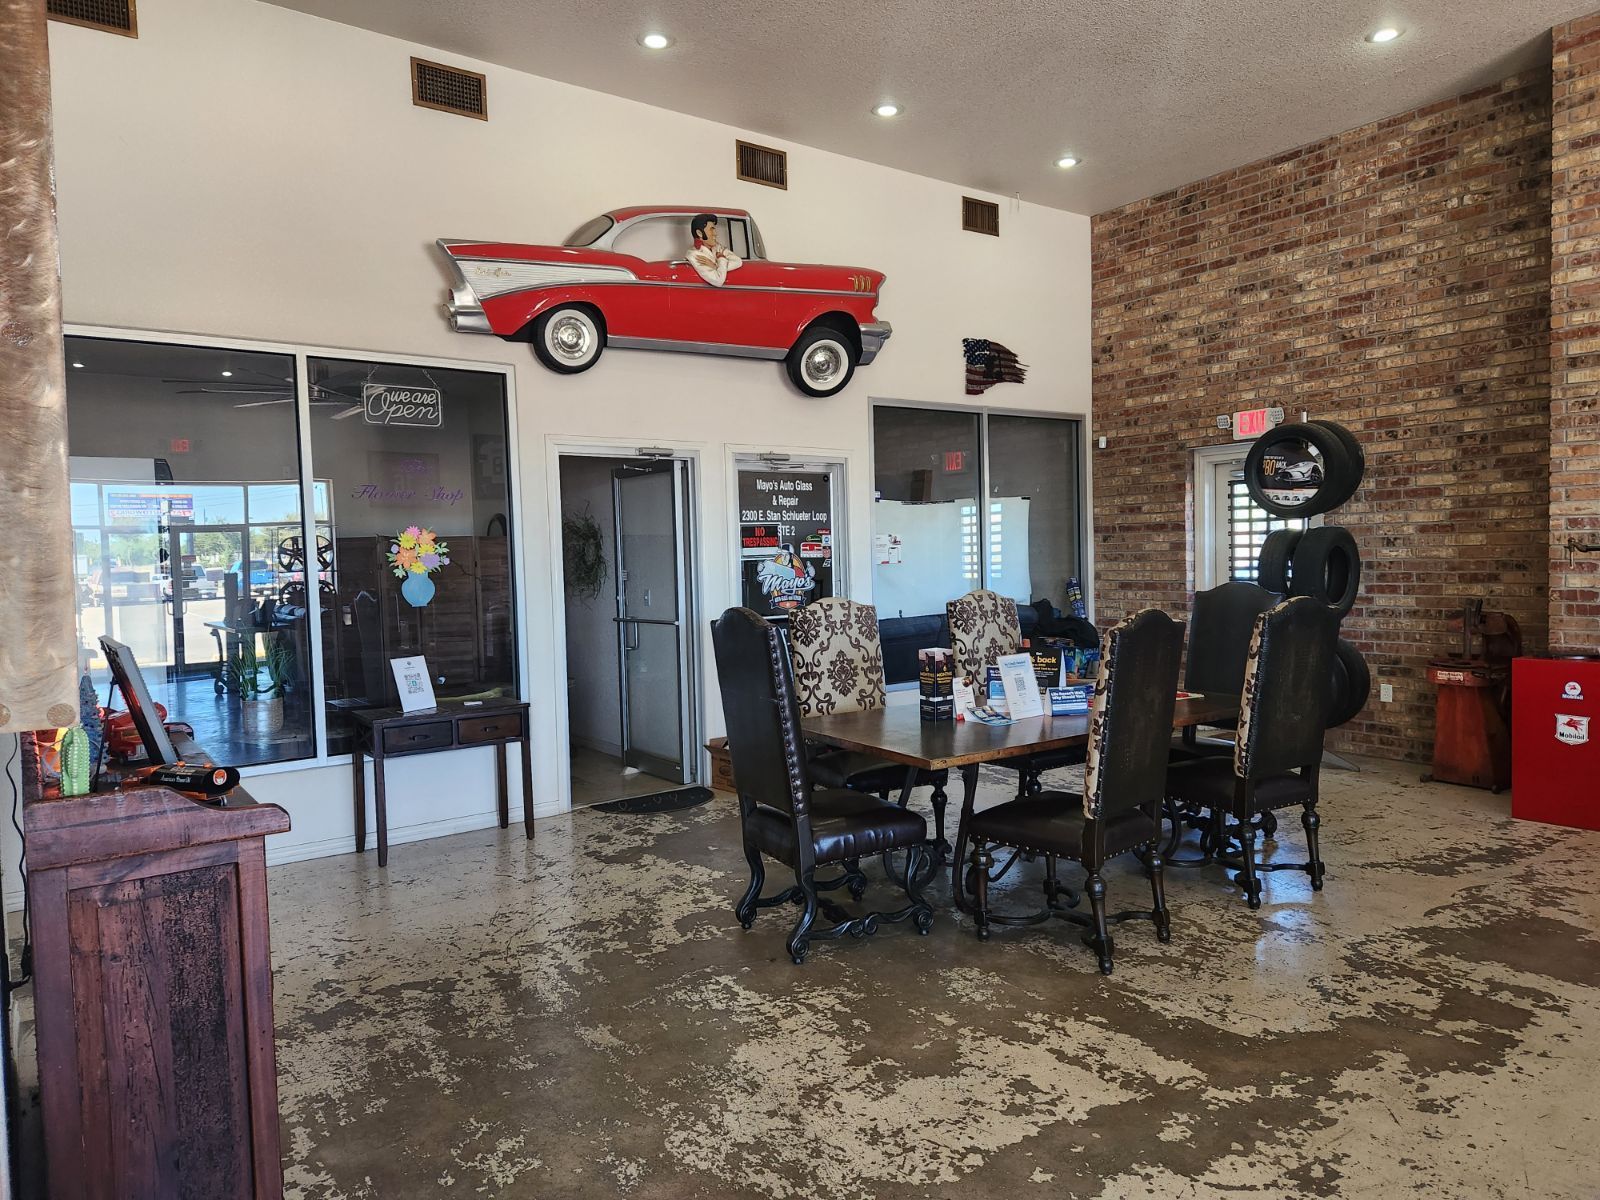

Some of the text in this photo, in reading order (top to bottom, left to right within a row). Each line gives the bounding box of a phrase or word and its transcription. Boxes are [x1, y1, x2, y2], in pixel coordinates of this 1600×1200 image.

[390, 390, 437, 405] we are
[368, 391, 439, 424] Open
[1239, 410, 1266, 435] EXIT
[756, 479, 813, 493] Mayo's Auto Glass
[772, 495, 799, 508] & Repair
[742, 510, 828, 523] 2300 E. Stan Schlueter Loop
[755, 527, 765, 536] NO
[777, 525, 796, 536] STE 2
[743, 537, 778, 547] TRESPASSING
[1037, 655, 1057, 664] back
[1559, 732, 1585, 741] Mobiloil
